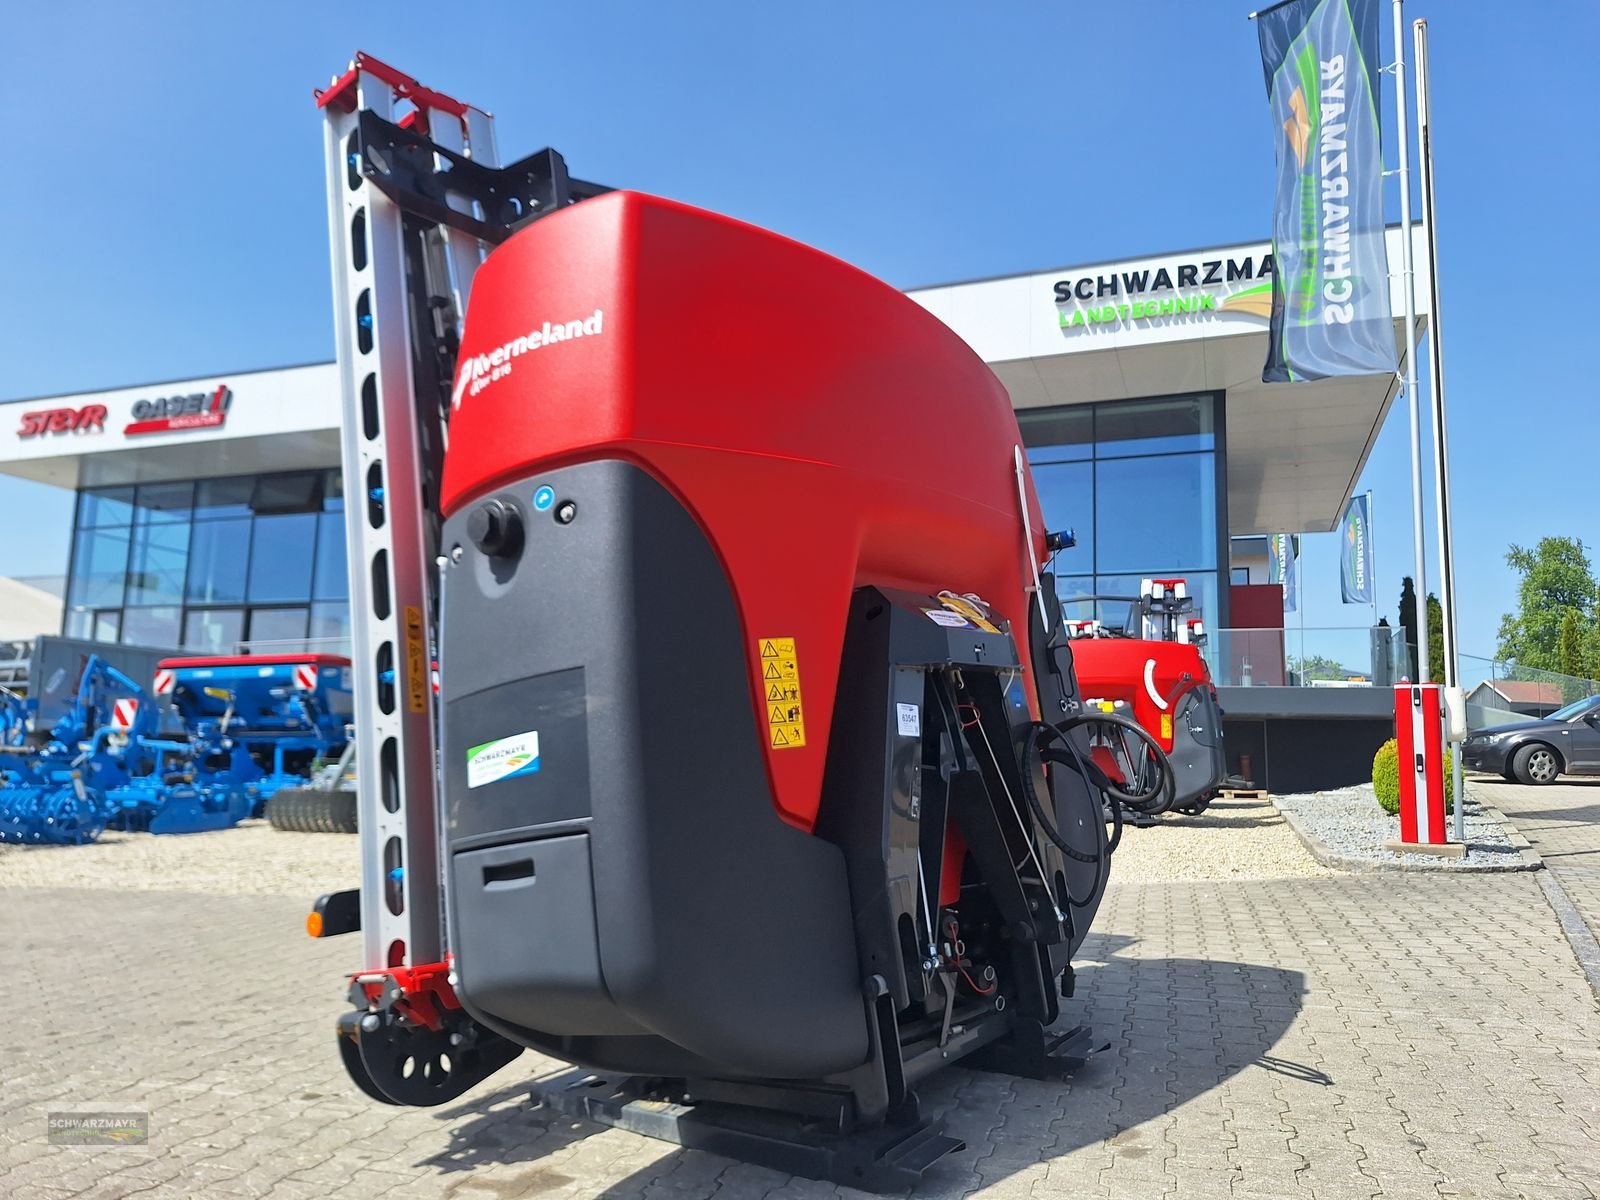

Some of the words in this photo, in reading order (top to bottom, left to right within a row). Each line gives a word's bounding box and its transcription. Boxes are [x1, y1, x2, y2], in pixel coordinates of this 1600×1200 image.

[1053, 253, 1273, 304] SCHWARZMA
[1058, 293, 1216, 328] LANDTECHNIK
[471, 308, 604, 381] Kverneland
[16, 404, 109, 437] STEYR
[131, 393, 205, 420] CASE
